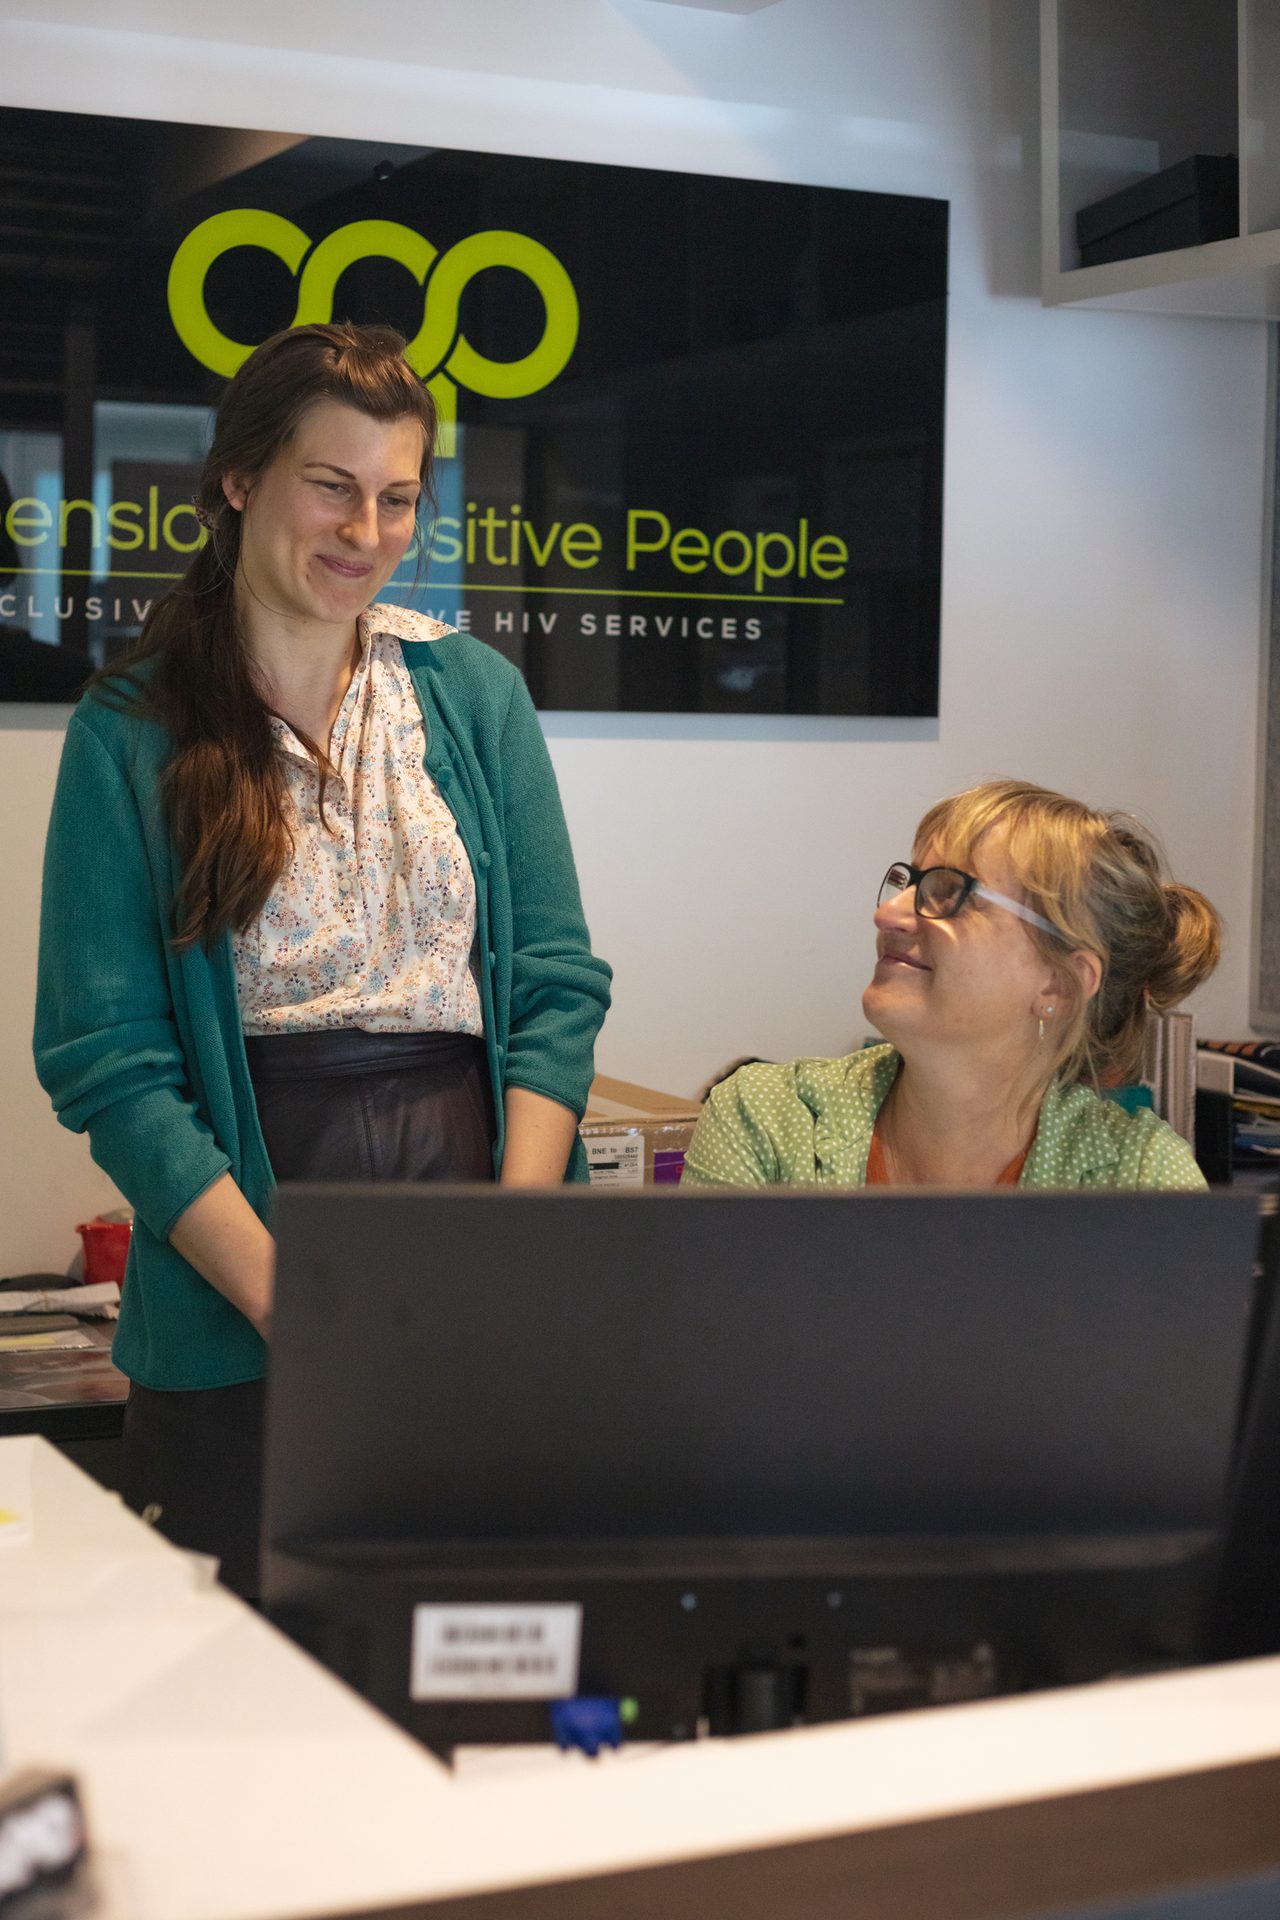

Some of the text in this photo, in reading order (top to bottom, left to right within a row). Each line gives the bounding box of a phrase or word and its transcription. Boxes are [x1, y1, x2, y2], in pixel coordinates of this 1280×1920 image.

[626, 509, 849, 593] People
[0, 593, 153, 622] CLUSIV
[495, 611, 558, 635] HIV
[580, 613, 763, 640] SERVICES
